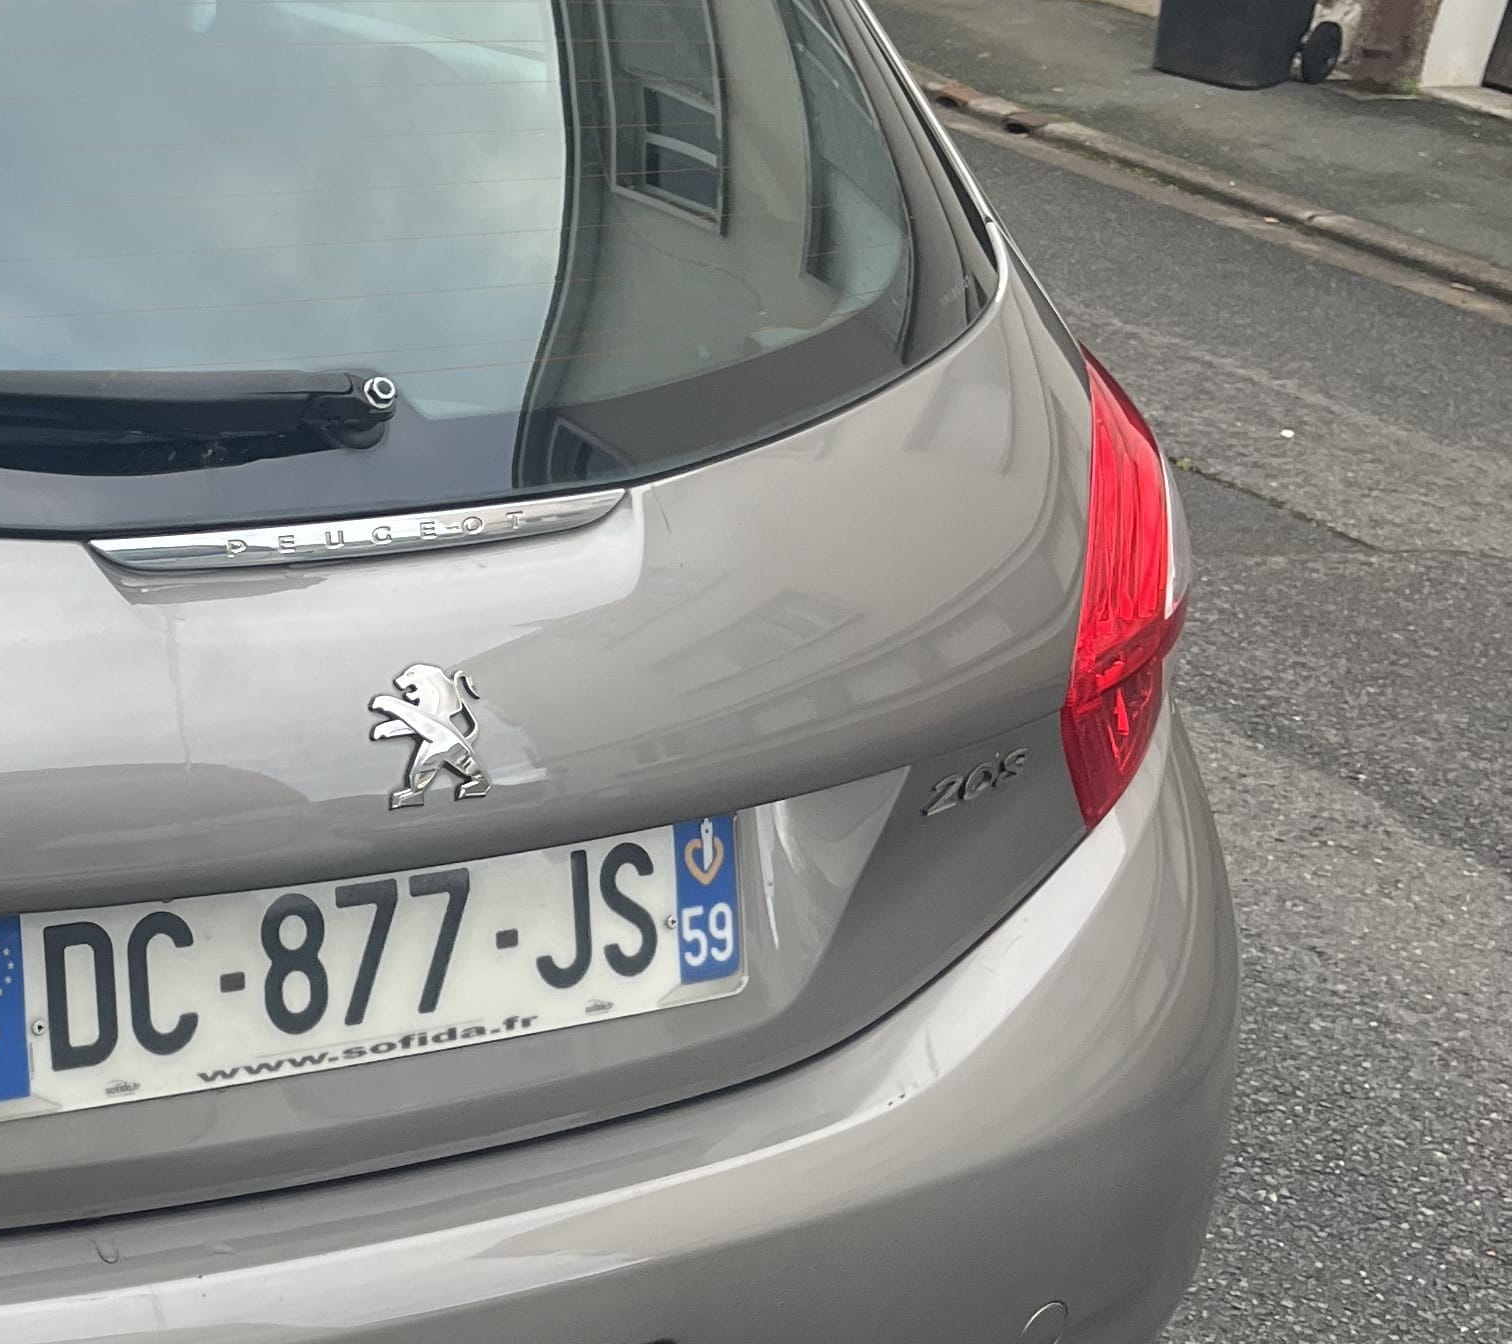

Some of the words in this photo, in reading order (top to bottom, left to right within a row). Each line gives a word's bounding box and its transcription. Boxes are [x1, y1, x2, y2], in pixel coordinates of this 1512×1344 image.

[226, 510, 525, 558] PEUGEOT
[43, 842, 659, 1072] DC-877-JS
[681, 902, 736, 968] 59
[197, 1015, 539, 1083] www.sofida.fr
